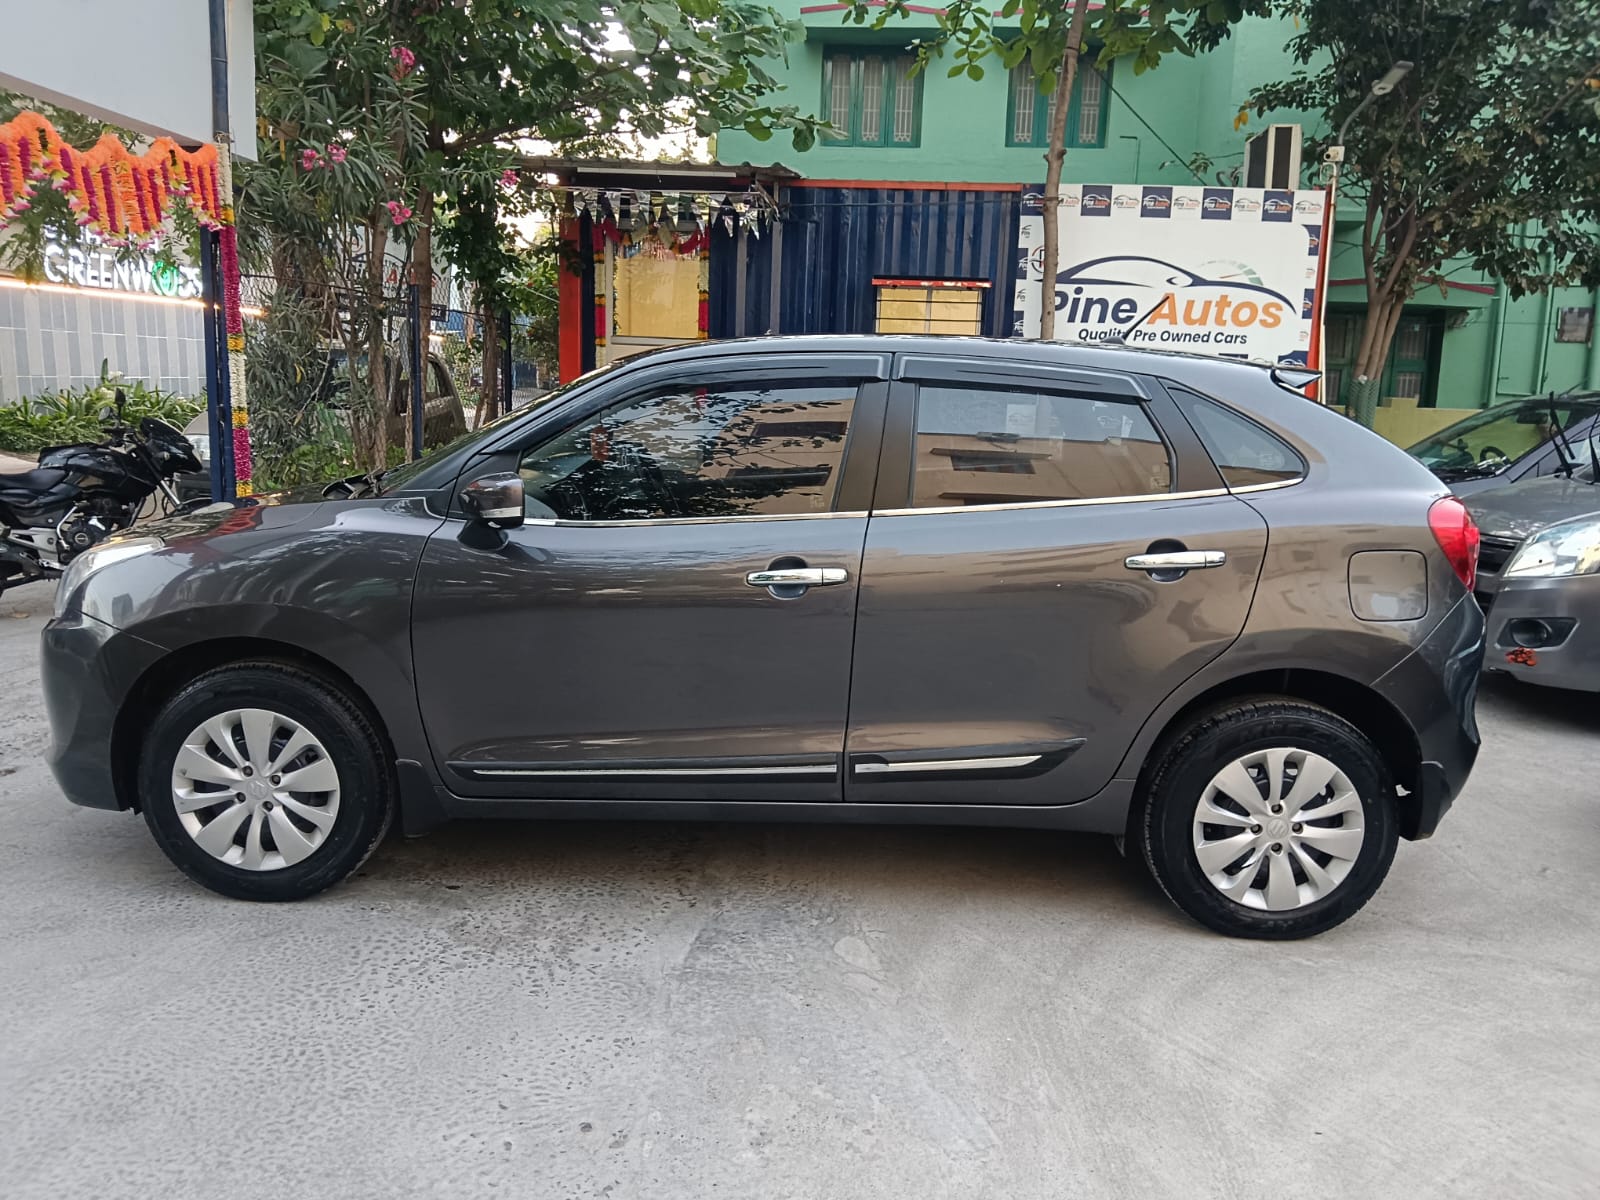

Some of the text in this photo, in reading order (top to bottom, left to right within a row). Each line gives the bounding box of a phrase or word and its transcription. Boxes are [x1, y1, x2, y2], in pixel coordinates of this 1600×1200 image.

[1146, 292, 1284, 329] Autos
[1078, 328, 1248, 344] Qualit Pre Owned Cars
